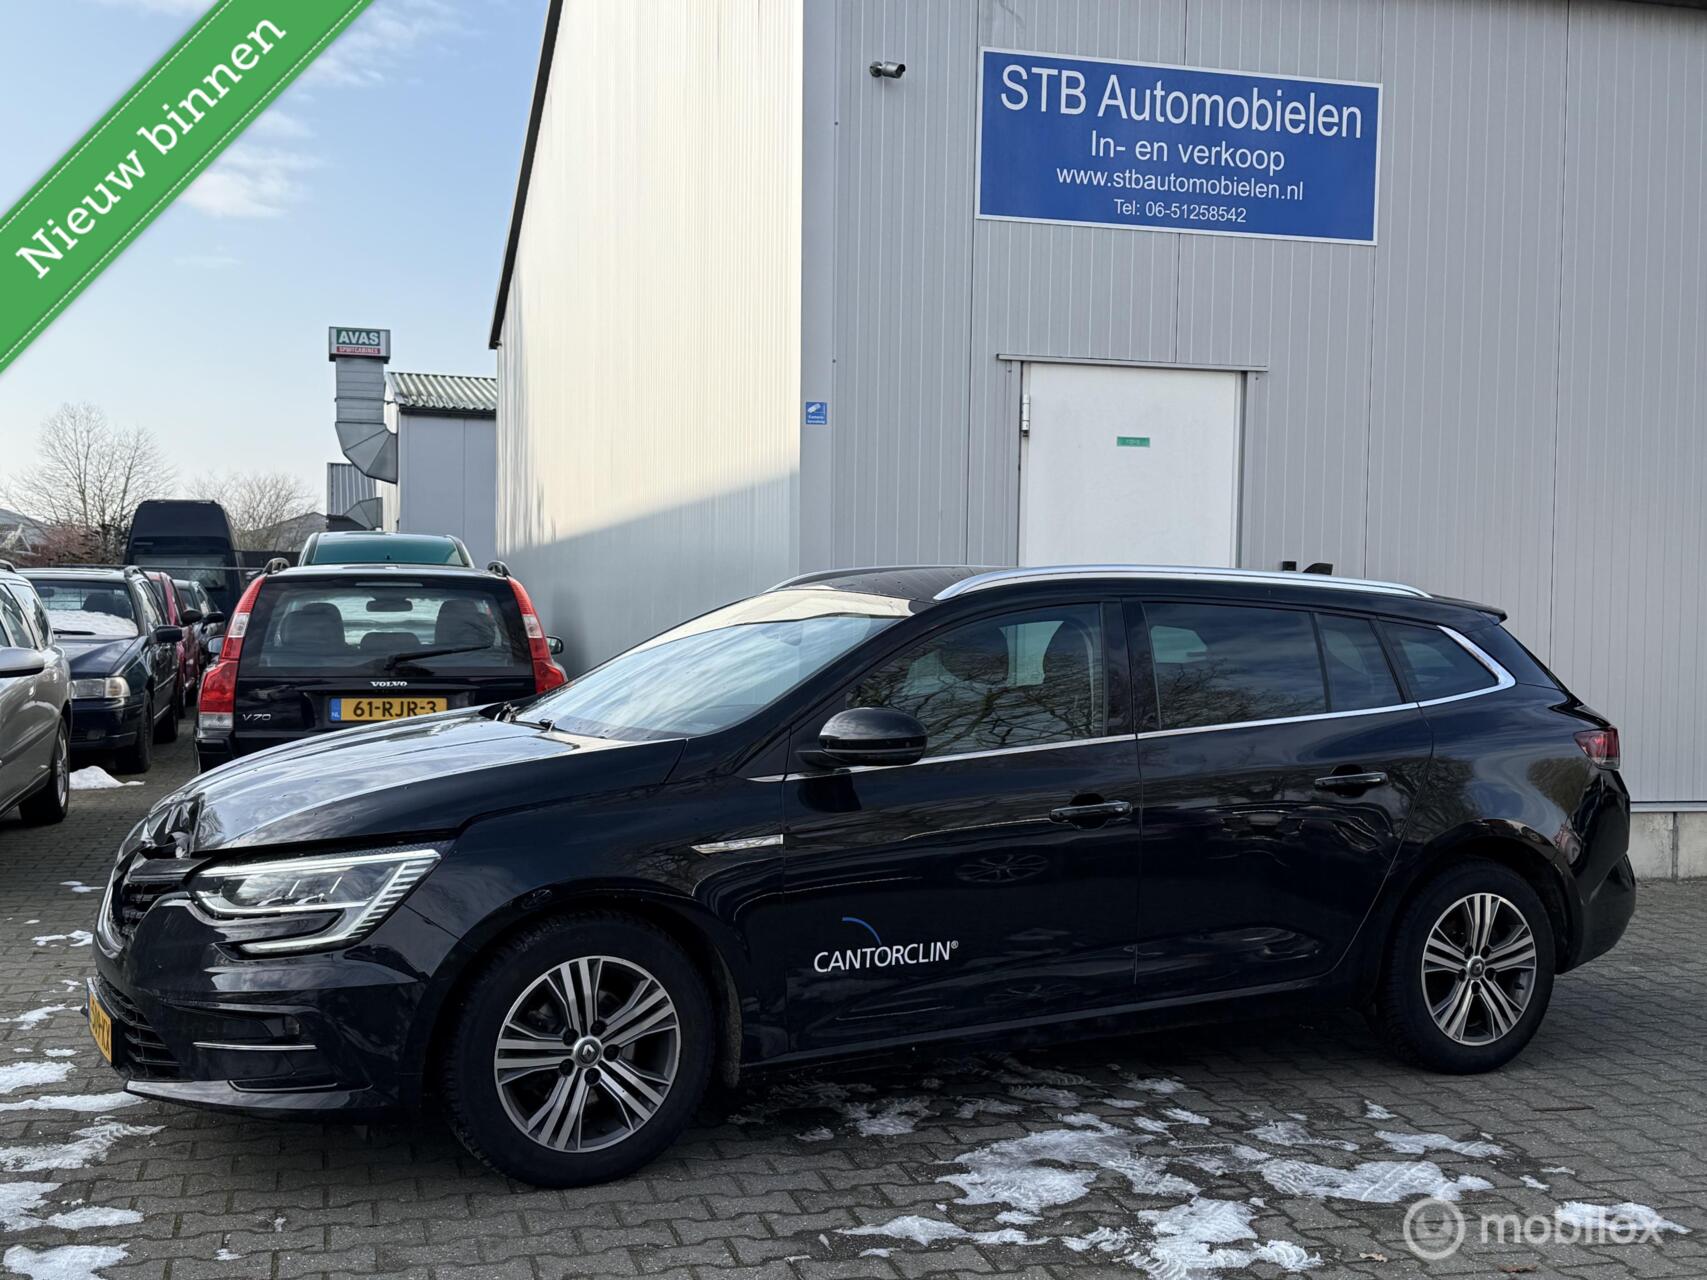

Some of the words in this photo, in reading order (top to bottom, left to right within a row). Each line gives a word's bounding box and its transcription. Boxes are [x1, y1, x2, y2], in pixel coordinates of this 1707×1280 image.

[1001, 64, 1087, 115] STB
[1097, 74, 1362, 139] Automobielen
[1091, 130, 1126, 158] In-
[1135, 140, 1168, 162] en
[1178, 141, 1285, 177] verkoop
[1057, 168, 1304, 200] www.stbautomobielen.nl
[1114, 199, 1140, 216] Tel:
[1145, 201, 1247, 223] 06-51258542
[338, 330, 379, 345] AVAS
[370, 680, 408, 688] VOLVO
[353, 701, 437, 718] 61-RJR-3
